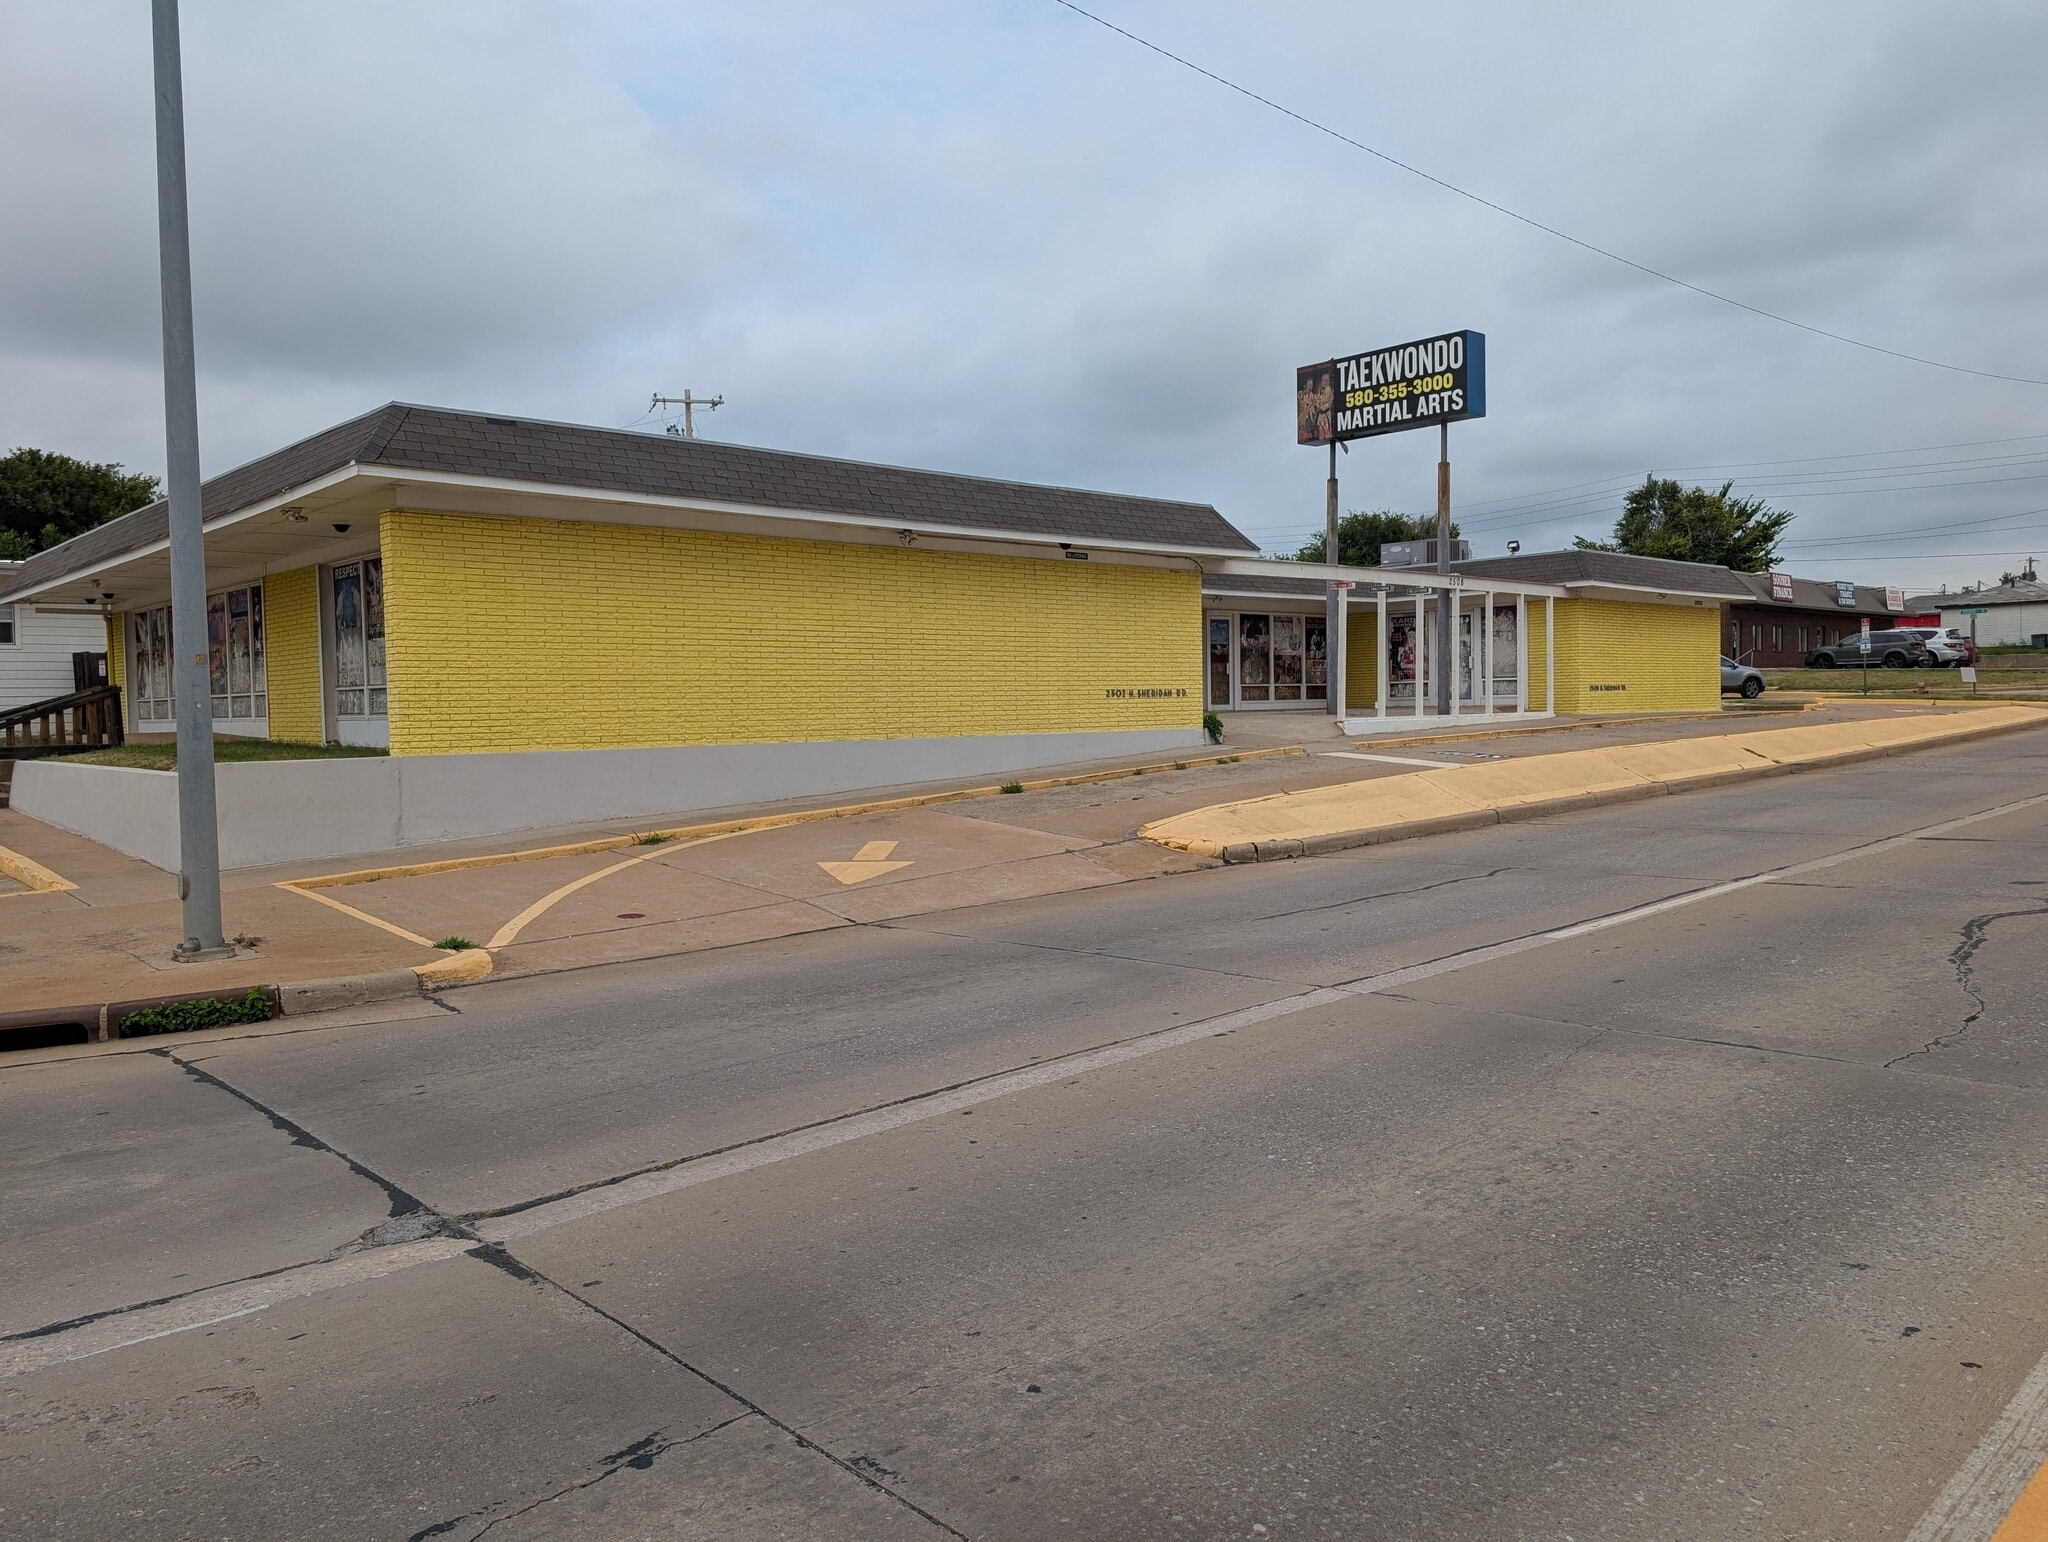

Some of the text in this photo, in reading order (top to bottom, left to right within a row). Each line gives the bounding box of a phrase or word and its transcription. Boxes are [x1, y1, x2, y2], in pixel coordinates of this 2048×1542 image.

[1336, 335, 1463, 392] TAEKWONDO
[1345, 372, 1454, 408] 580-355-3000
[1336, 388, 1464, 432] MARTIAL ARTS
[335, 564, 359, 579] RESPECT
[1773, 574, 1792, 587] SOONER
[1773, 586, 1793, 599] FINANCE
[1137, 689, 1173, 698] SHERIDAN
